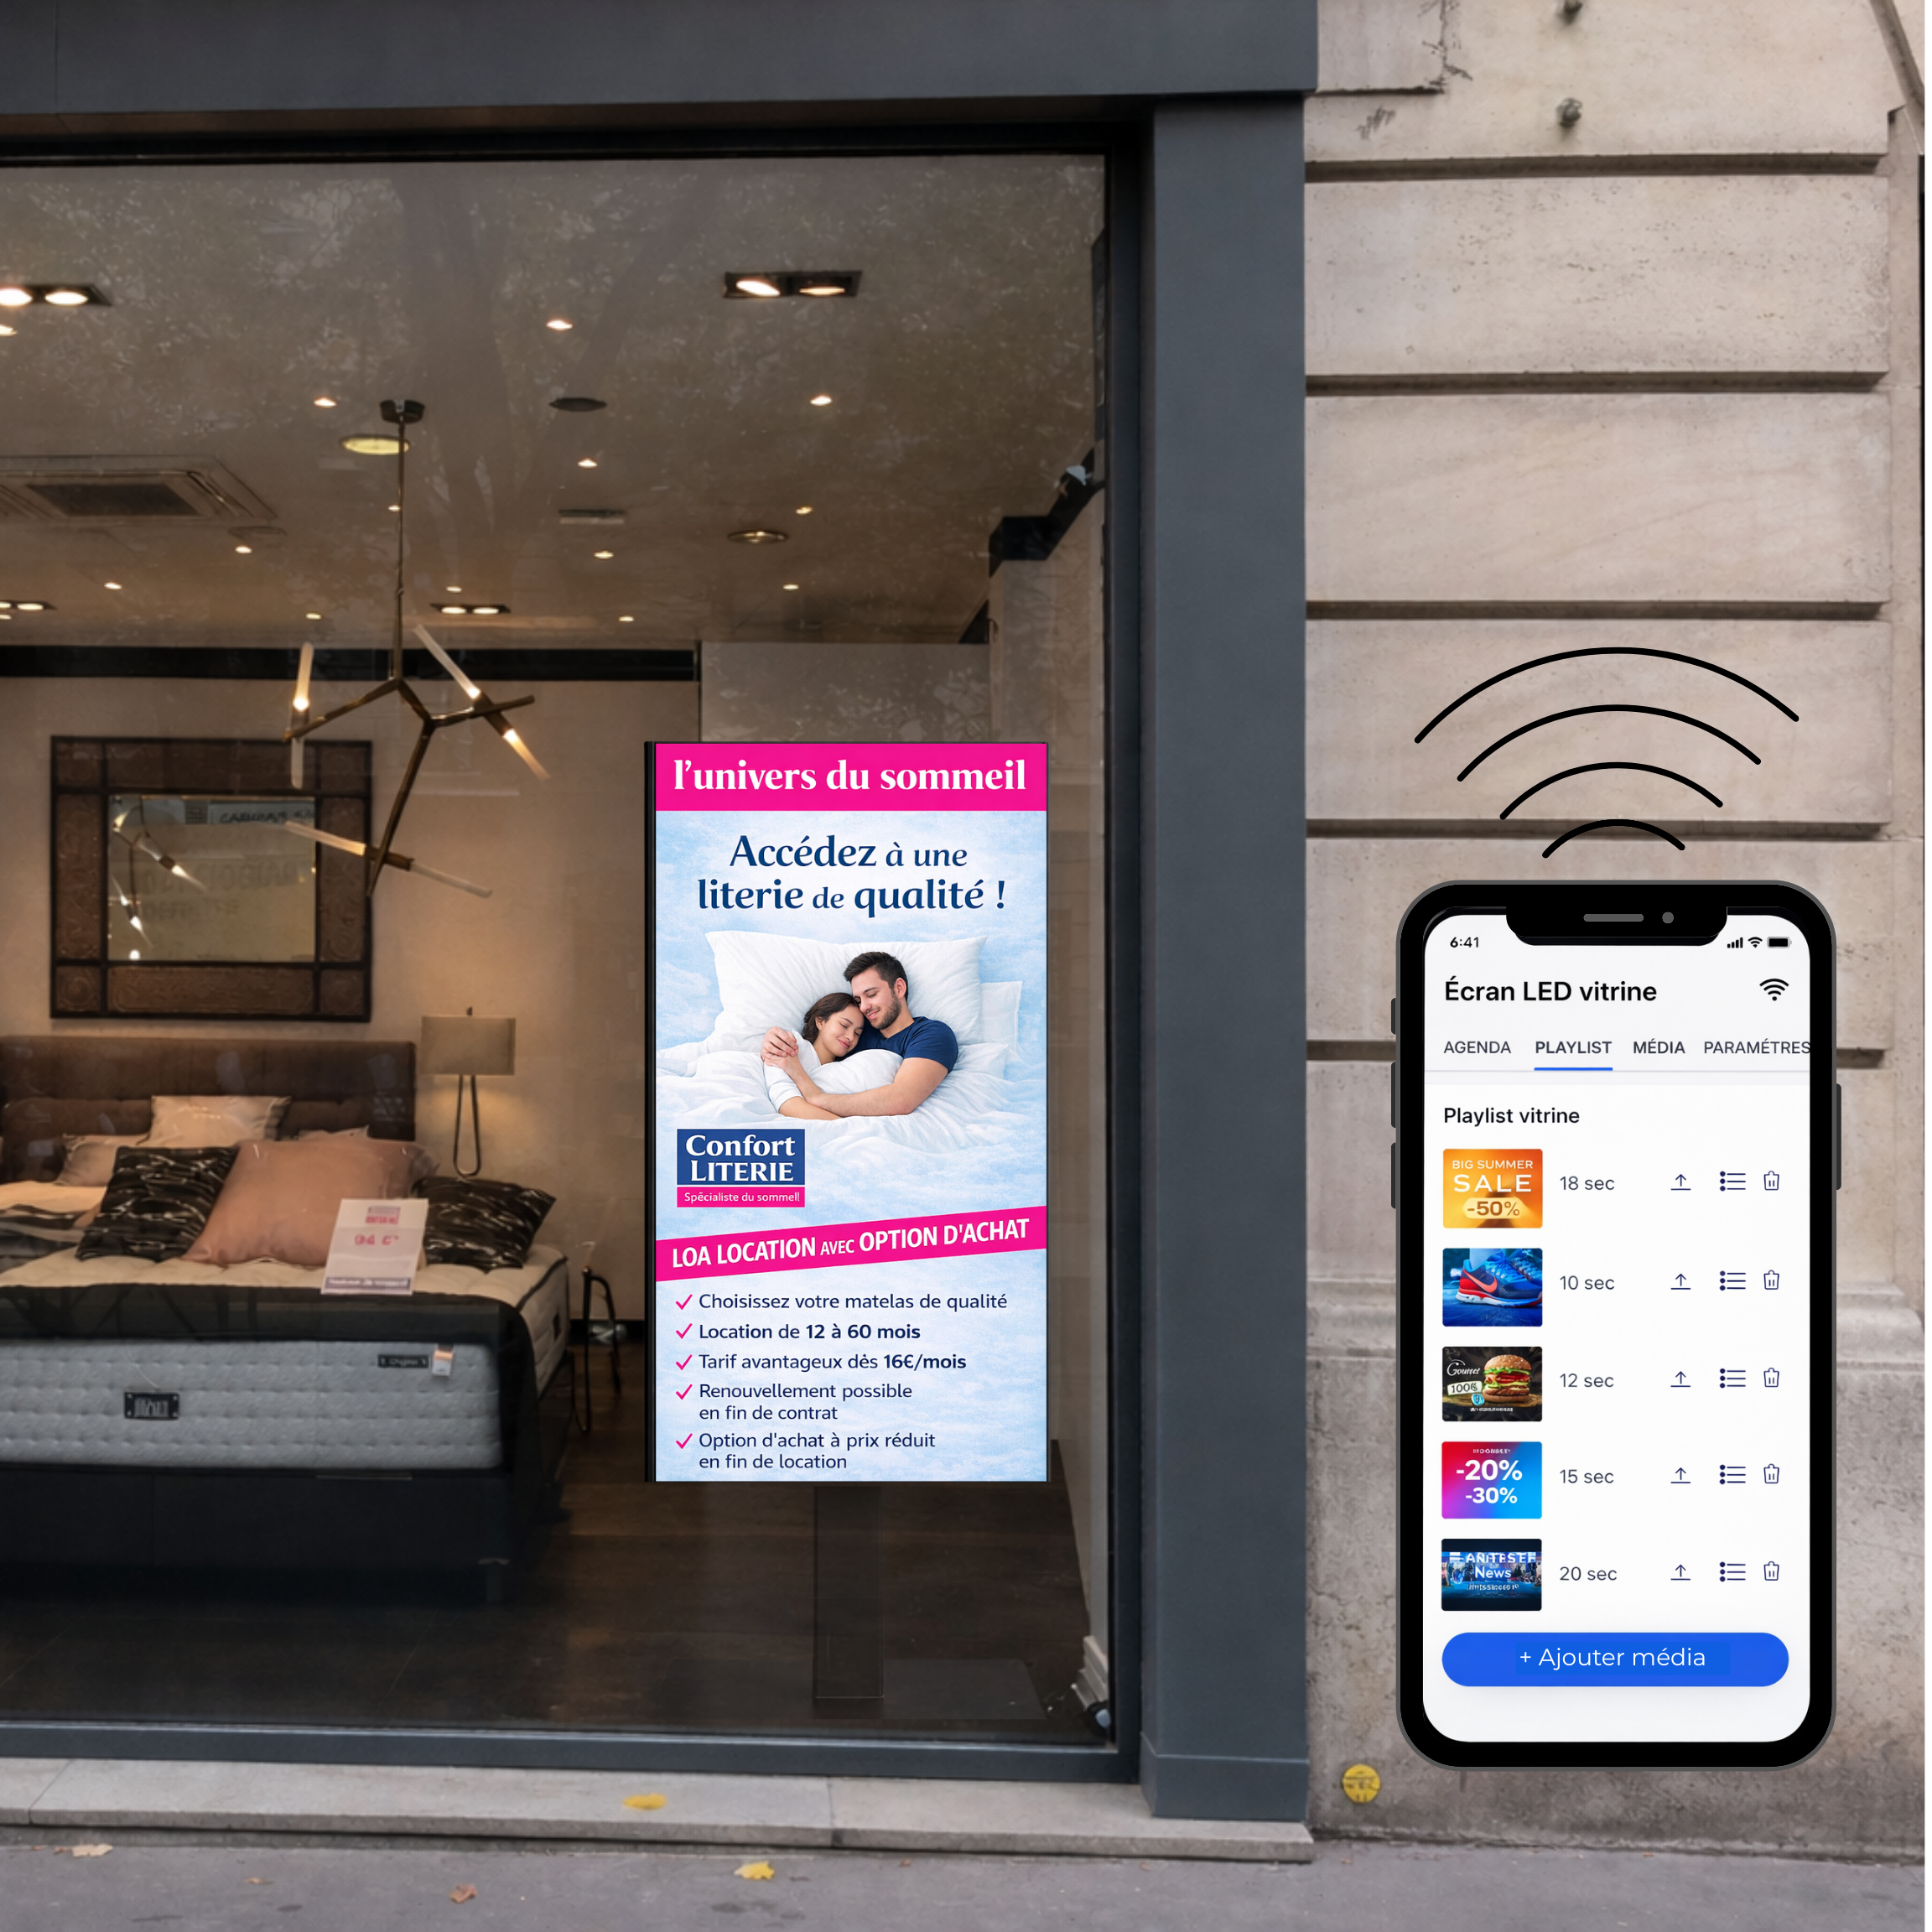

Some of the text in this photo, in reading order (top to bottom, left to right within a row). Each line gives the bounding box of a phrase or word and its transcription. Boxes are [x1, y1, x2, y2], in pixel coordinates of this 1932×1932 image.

[827, 760, 870, 789] du
[880, 760, 1026, 789] sommeil
[730, 835, 967, 866] Accédez à une
[698, 879, 1005, 918] literie de qualité !
[1450, 937, 1478, 948] 6:41
[1446, 976, 1656, 1000] Écran LED vitrine
[1444, 1041, 1511, 1053] AGENDA
[1536, 1041, 1612, 1053] PLAYLIST
[1633, 1038, 1685, 1053] MÉDIA
[1445, 1108, 1579, 1127] Playlist vitrine
[686, 1135, 795, 1156] Confort
[691, 1161, 793, 1181] LITERIE
[1452, 1160, 1534, 1170] BIG SUMMER
[1453, 1173, 1532, 1193] SALE
[1561, 1176, 1614, 1190] 18 sec
[685, 1192, 739, 1202] Spécialiste
[742, 1192, 754, 1201] du
[1467, 1201, 1519, 1216] -50%
[673, 1218, 1029, 1267] LOA LOCATION AVEC OPTION D'ACHAT
[1561, 1275, 1614, 1290] 10 sec
[699, 1294, 1007, 1311] Choisissez votre matelas de qualité
[700, 1323, 920, 1338] Location de 12 à 60 mois
[699, 1354, 737, 1368] Tarif
[742, 1356, 842, 1372] avantageux
[884, 1354, 966, 1371] 16€/mois
[1561, 1374, 1613, 1387] 12 sec
[700, 1384, 911, 1401] Renouvellement possible
[699, 1405, 838, 1419] en fin de contrat
[699, 1432, 935, 1450] Option d'achat à prix réduit
[699, 1454, 846, 1468] en fin de location
[1456, 1459, 1524, 1482] -20%
[1561, 1470, 1613, 1483] 15 sec
[1465, 1487, 1519, 1504] -30%
[1474, 1566, 1512, 1578] News
[1561, 1566, 1617, 1581] 20 sec
[1520, 1648, 1705, 1670] + Ajouter média
